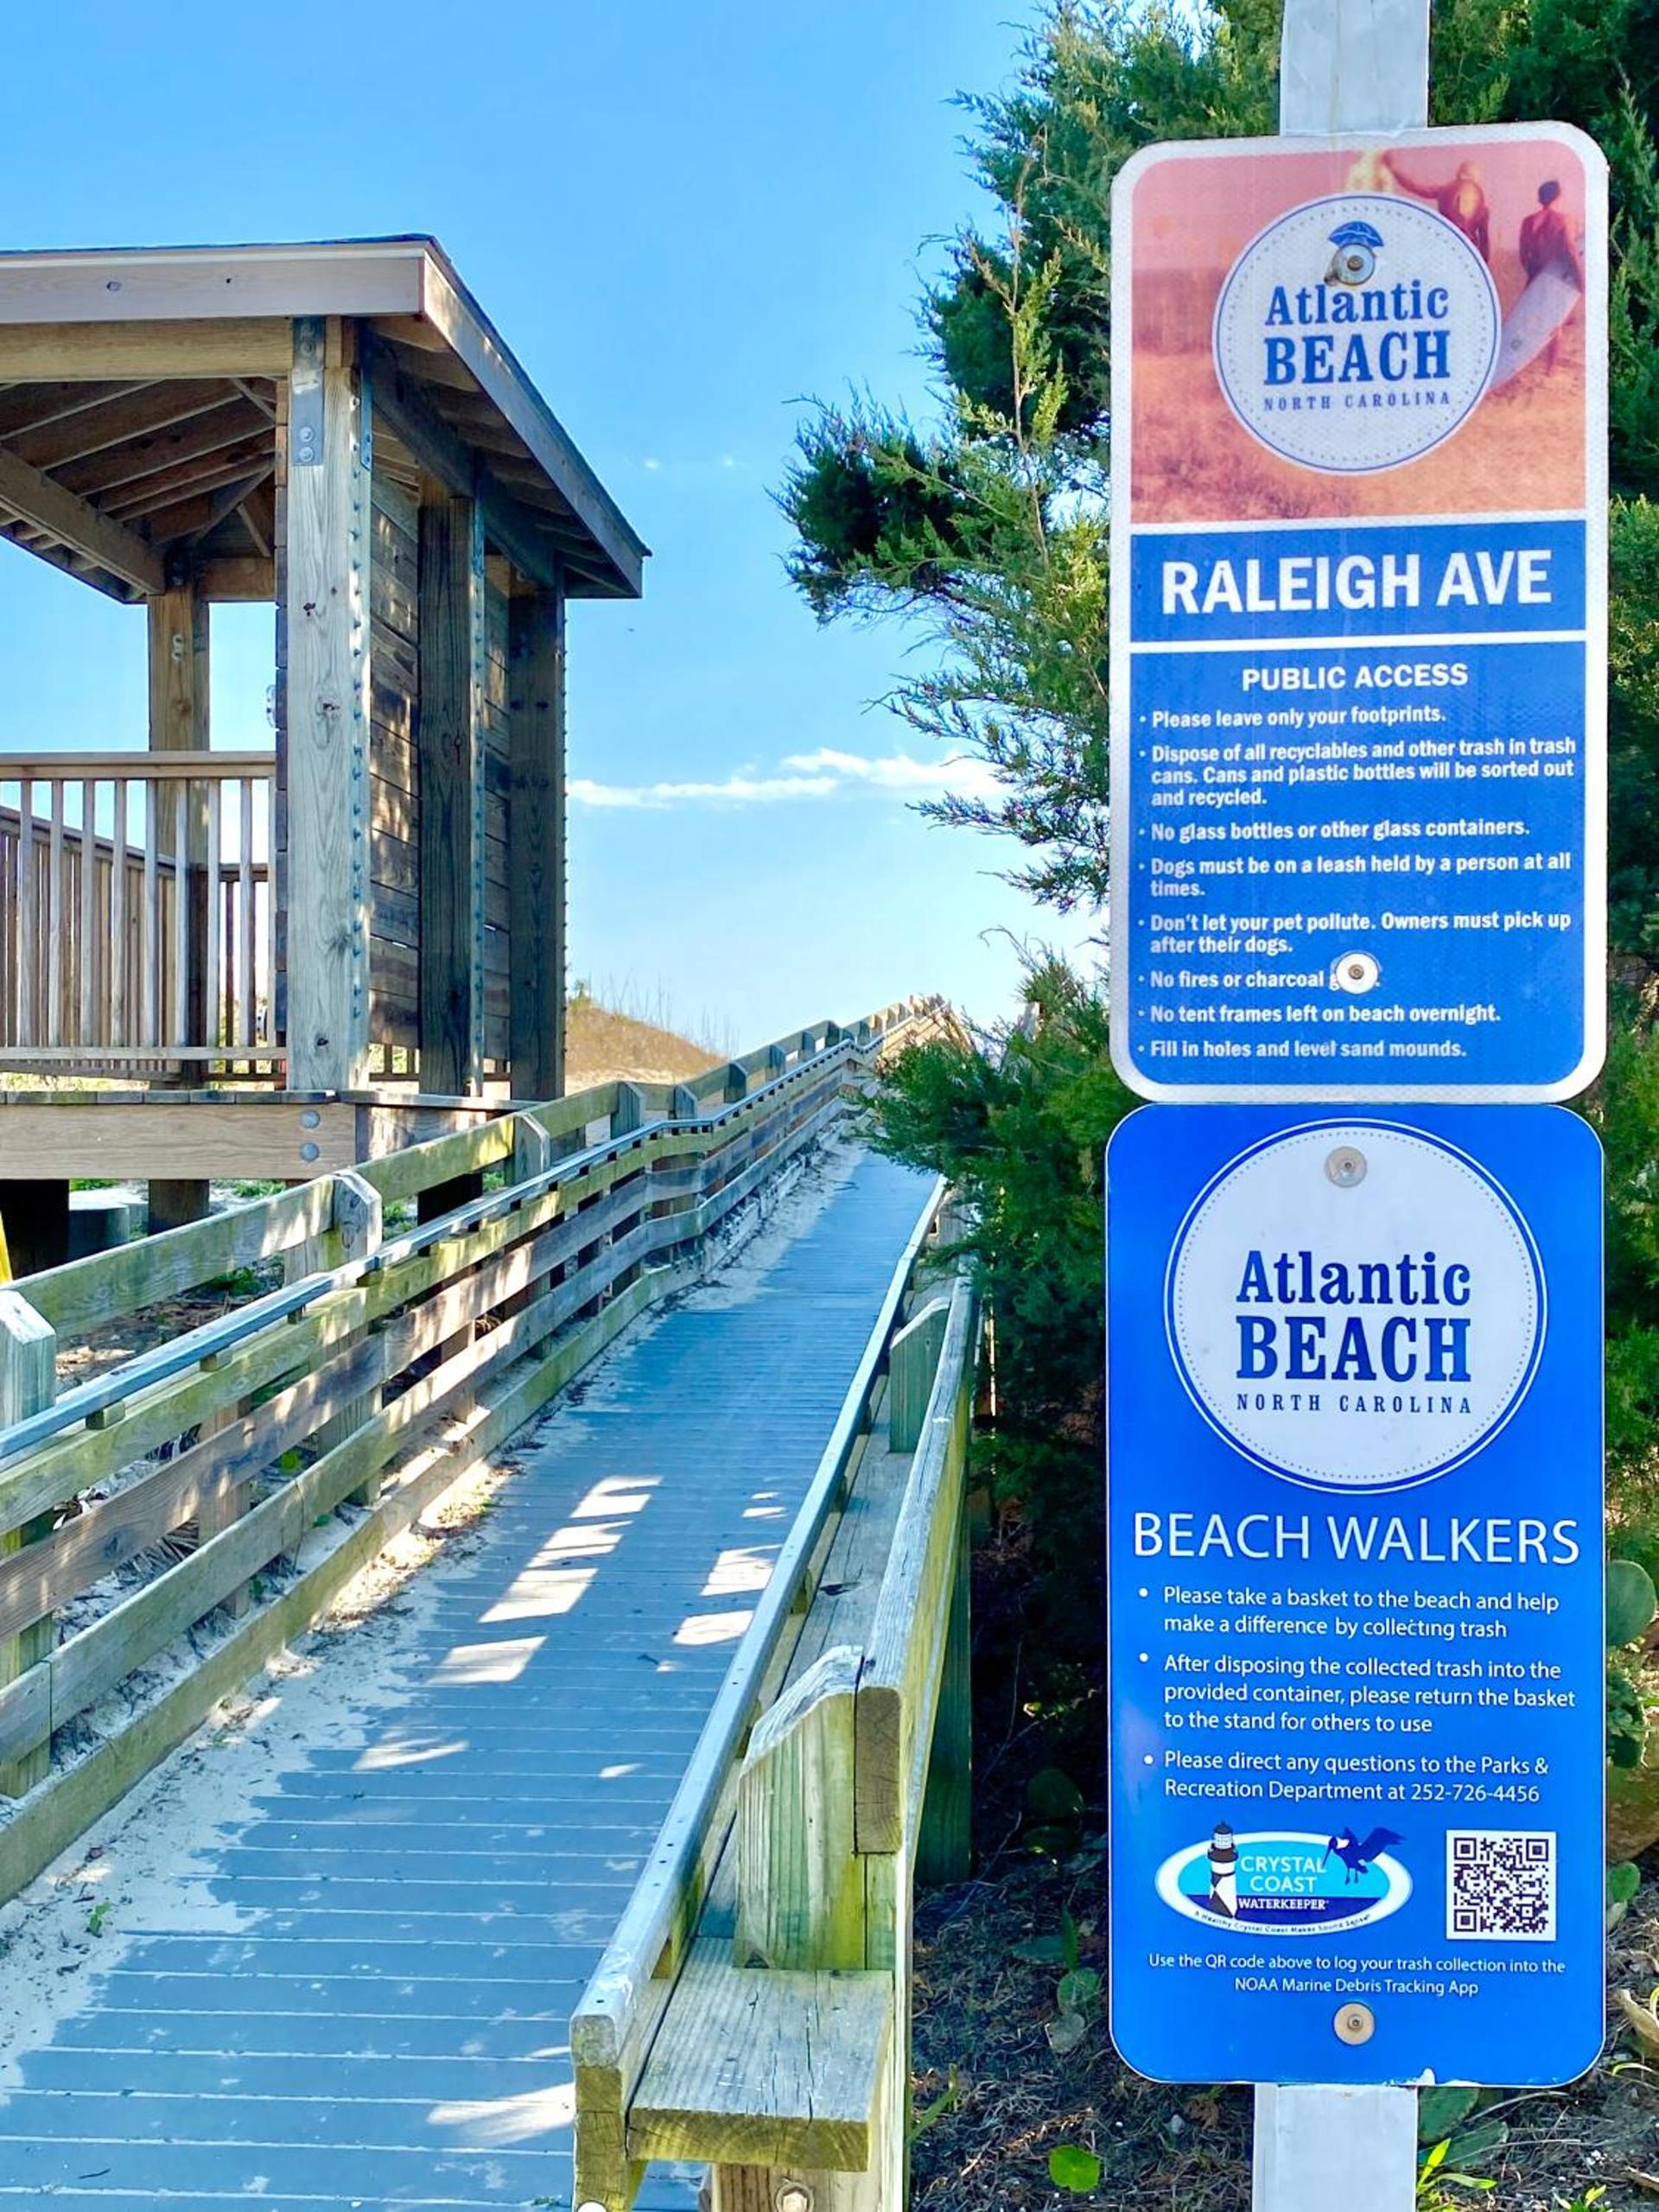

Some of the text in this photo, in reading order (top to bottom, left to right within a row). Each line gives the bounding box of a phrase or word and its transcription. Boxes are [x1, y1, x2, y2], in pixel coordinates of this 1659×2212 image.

[1264, 279, 1448, 326] Atlantic
[1263, 329, 1451, 385] BEACH
[1264, 391, 1450, 411] NORTH CAROLINA
[1162, 549, 1552, 615] RALEIGH AVE
[1243, 663, 1469, 691] PUBLIC ACCESS
[1152, 704, 1446, 729] Please leave only your footprints.
[1152, 736, 1577, 766] Dispose of all recyclables and other trash in trash
[1151, 759, 1575, 785] cans. Cans and plastic bottles will be sorted out
[1151, 787, 1268, 809] and recycled.
[1151, 818, 1530, 844] No glass bottles or other glass containers.
[1151, 851, 1572, 879] Dogs must be on a leash held by a person at all
[1150, 880, 1205, 897] times.
[1151, 911, 1572, 935] Don't let your pet pollute. Owners must pick up
[1150, 934, 1294, 957] after their dogs.
[1150, 970, 1175, 988] No
[1178, 969, 1219, 988] fires
[1222, 974, 1243, 988] or
[1244, 969, 1325, 988] charcoal
[1150, 1003, 1501, 1026] No tent frames left on beach overnight.
[1150, 1039, 1466, 1058] Fill in holes and level sand mounds.
[1236, 1249, 1471, 1306] Atlantic
[1236, 1315, 1471, 1382] BEACH
[1236, 1393, 1471, 1414] NORTH CAROLINA
[1135, 1512, 1580, 1565] BEACH WALKERS
[1164, 1586, 1560, 1615] Please take a basket to the beach and help
[1164, 1613, 1507, 1641] make a difference by collecting trash
[1164, 1653, 1561, 1679] After disposing the collected trash into the
[1164, 1682, 1575, 1707] provided container, please return the basket
[1164, 1710, 1433, 1732] to the stand for others to use
[1164, 1750, 1549, 1775] Please direct any questions to the Parks &
[1165, 1778, 1540, 1802] Recreation Department at 252-726-4456
[1241, 1856, 1327, 1873] CRYSTAL
[1250, 1875, 1318, 1892] COAST
[1149, 1953, 1566, 1974] Use the QR code above to log your trash collection into the
[1235, 1977, 1479, 1998] NOAA Marine Debris Tracking App
